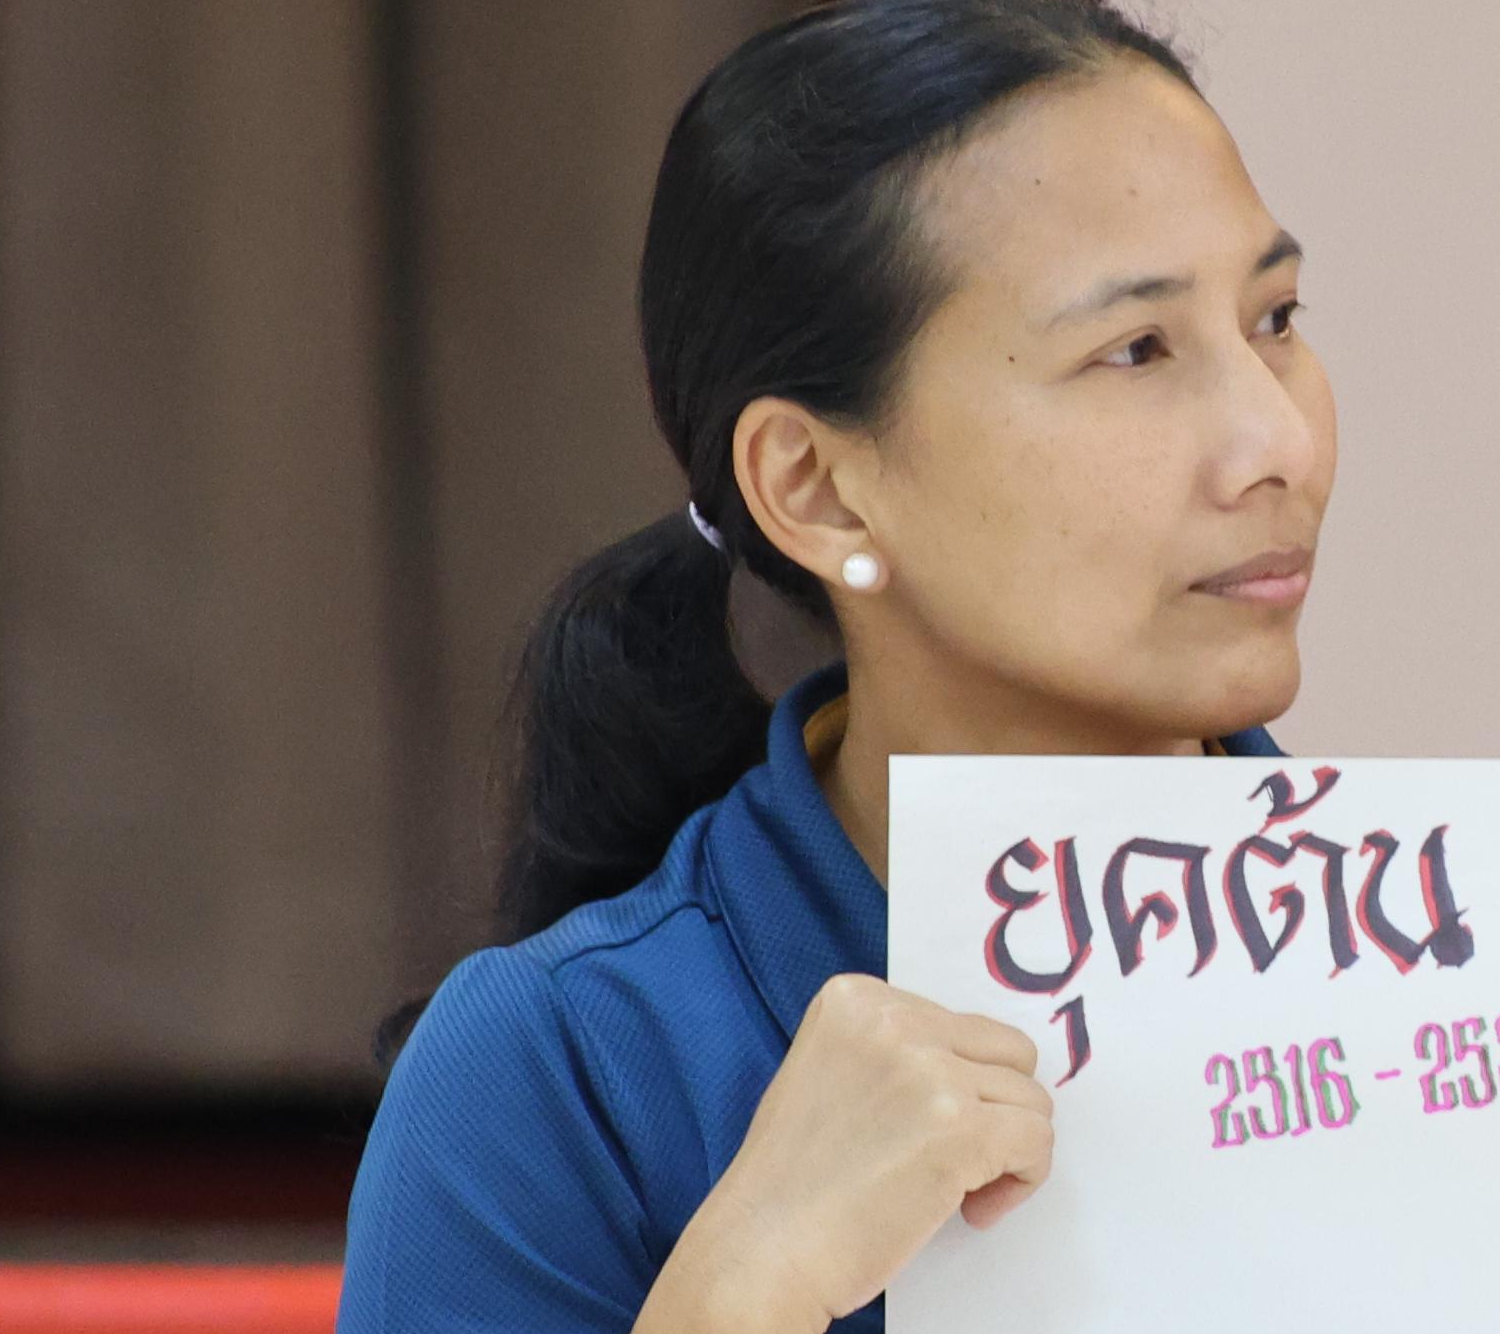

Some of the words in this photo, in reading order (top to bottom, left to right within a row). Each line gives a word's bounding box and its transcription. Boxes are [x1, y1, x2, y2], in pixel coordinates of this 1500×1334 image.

[983, 765, 1476, 1089] ยุคต้น
[1203, 1036, 1362, 1149] 2516
